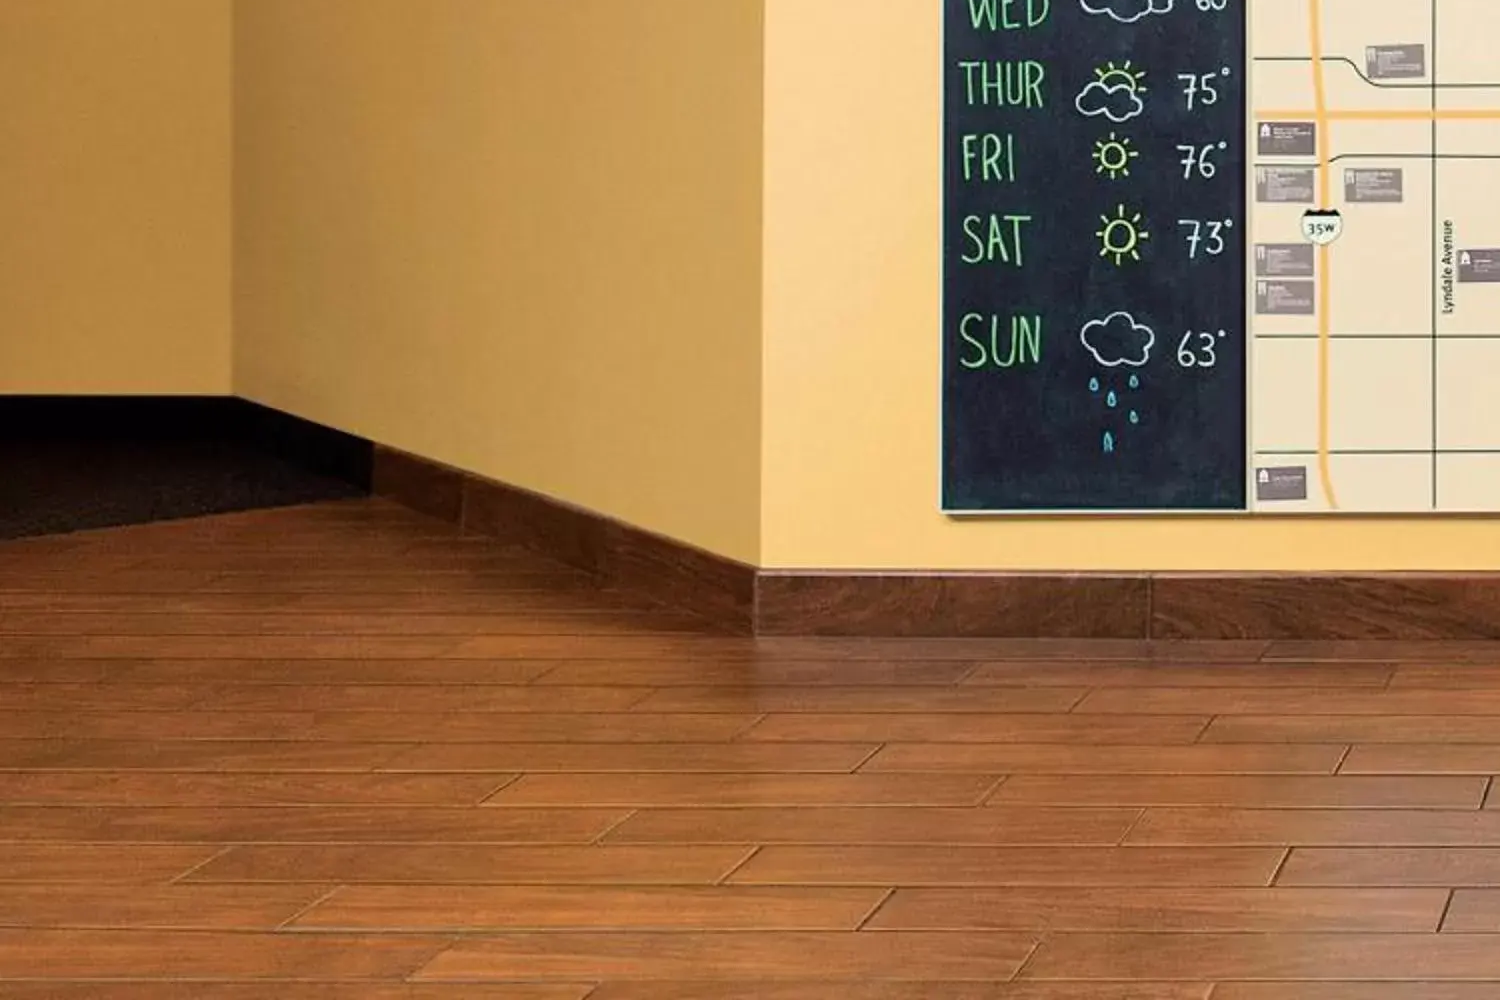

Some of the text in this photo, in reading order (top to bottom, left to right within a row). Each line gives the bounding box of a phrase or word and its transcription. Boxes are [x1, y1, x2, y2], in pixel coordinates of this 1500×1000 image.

[958, 60, 1044, 108] THUR
[962, 133, 1015, 182] FRI
[962, 215, 1031, 266] SAT
[1308, 223, 1335, 236] 35W
[1442, 220, 1454, 314] Lyndale Avenue
[960, 313, 1041, 368] SUN
